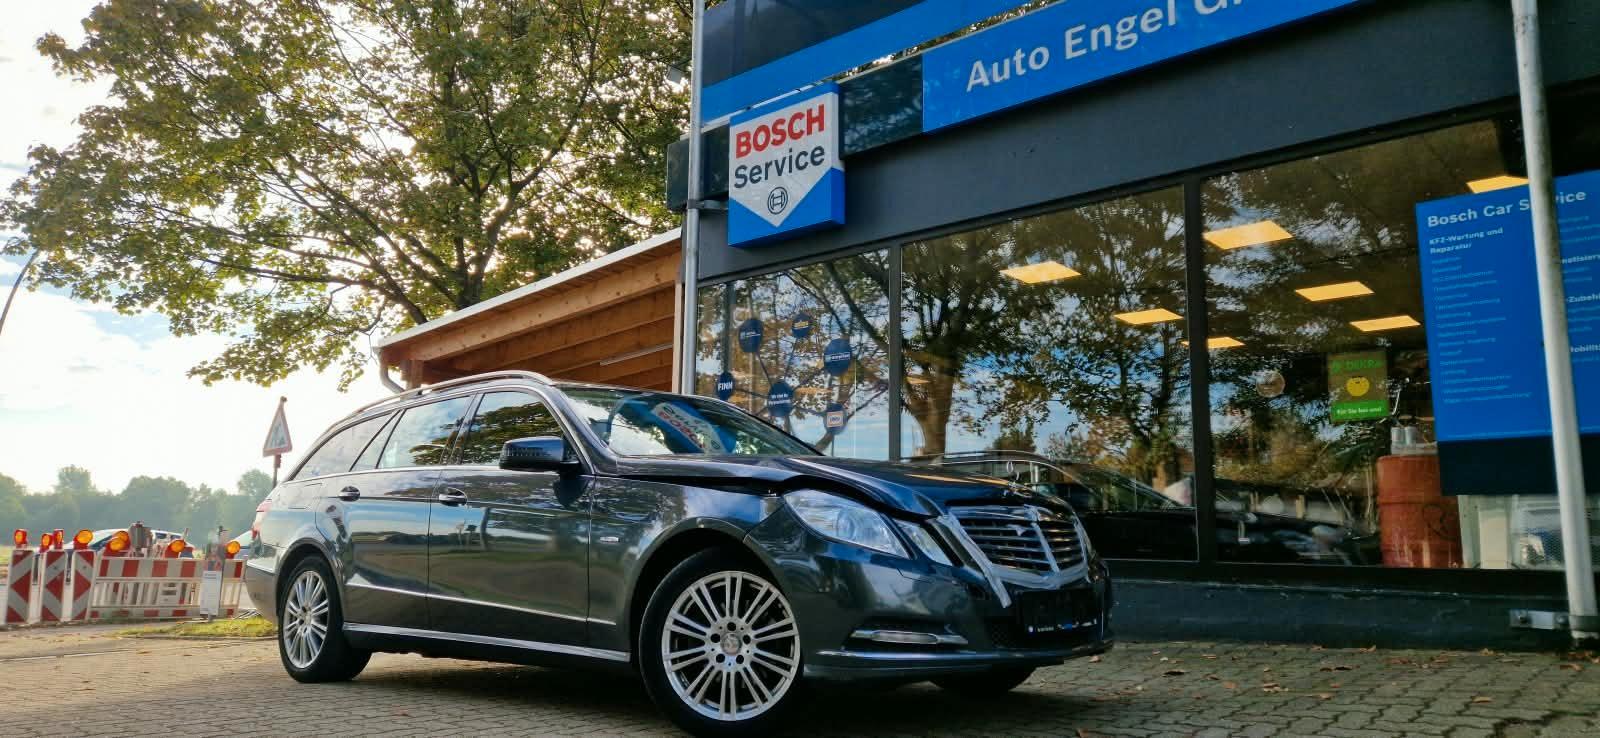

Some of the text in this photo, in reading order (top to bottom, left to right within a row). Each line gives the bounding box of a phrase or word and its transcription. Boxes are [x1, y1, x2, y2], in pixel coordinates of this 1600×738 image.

[966, 0, 1176, 92] Auto Engel
[736, 104, 825, 159] BOSCH
[734, 145, 825, 189] Service
[1427, 191, 1587, 228] Bosch Car Sice
[717, 381, 733, 392] FINN
